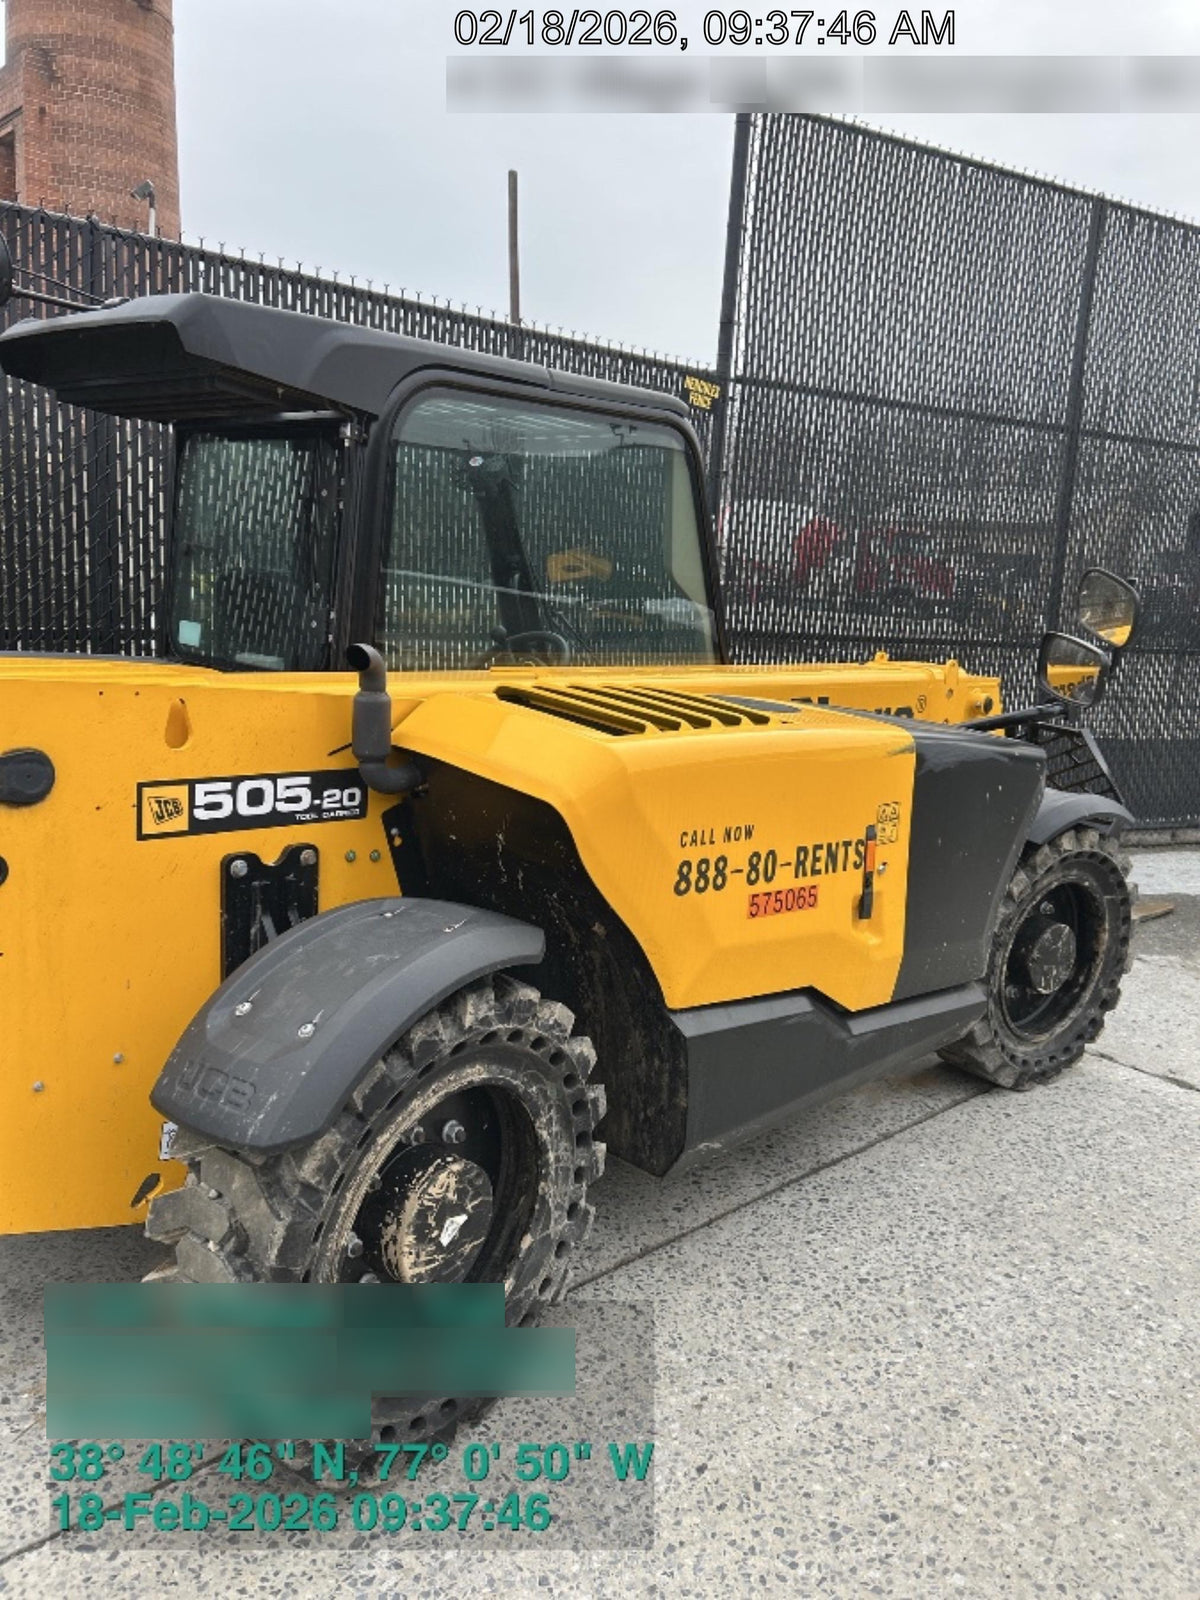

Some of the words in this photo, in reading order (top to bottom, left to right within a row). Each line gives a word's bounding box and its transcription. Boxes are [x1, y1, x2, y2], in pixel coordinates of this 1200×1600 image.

[150, 796, 184, 824] JCB
[193, 776, 362, 820] 505-20
[680, 828, 716, 848] CALL
[723, 824, 755, 843] NOW
[673, 839, 866, 897] 888-80-RENTS
[749, 885, 818, 918] 575065
[176, 1060, 258, 1111] JCB
